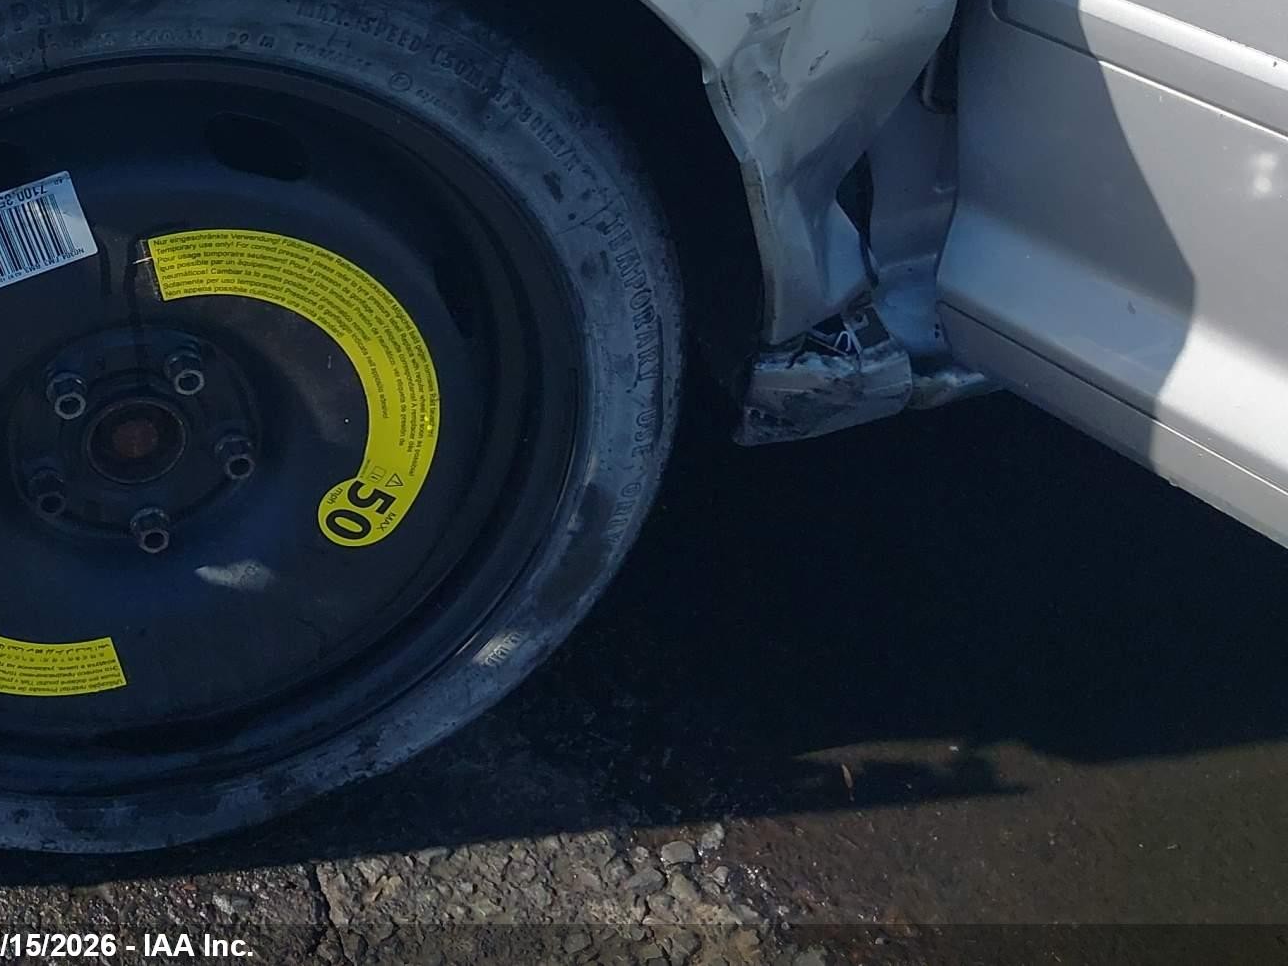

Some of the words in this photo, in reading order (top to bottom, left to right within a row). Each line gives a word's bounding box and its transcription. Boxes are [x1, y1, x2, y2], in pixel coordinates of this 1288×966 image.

[604, 214, 659, 382] TEMPORARY
[633, 408, 654, 459] USE
[325, 480, 397, 540] 50
[327, 487, 344, 505] mph
[376, 512, 397, 532] MAX
